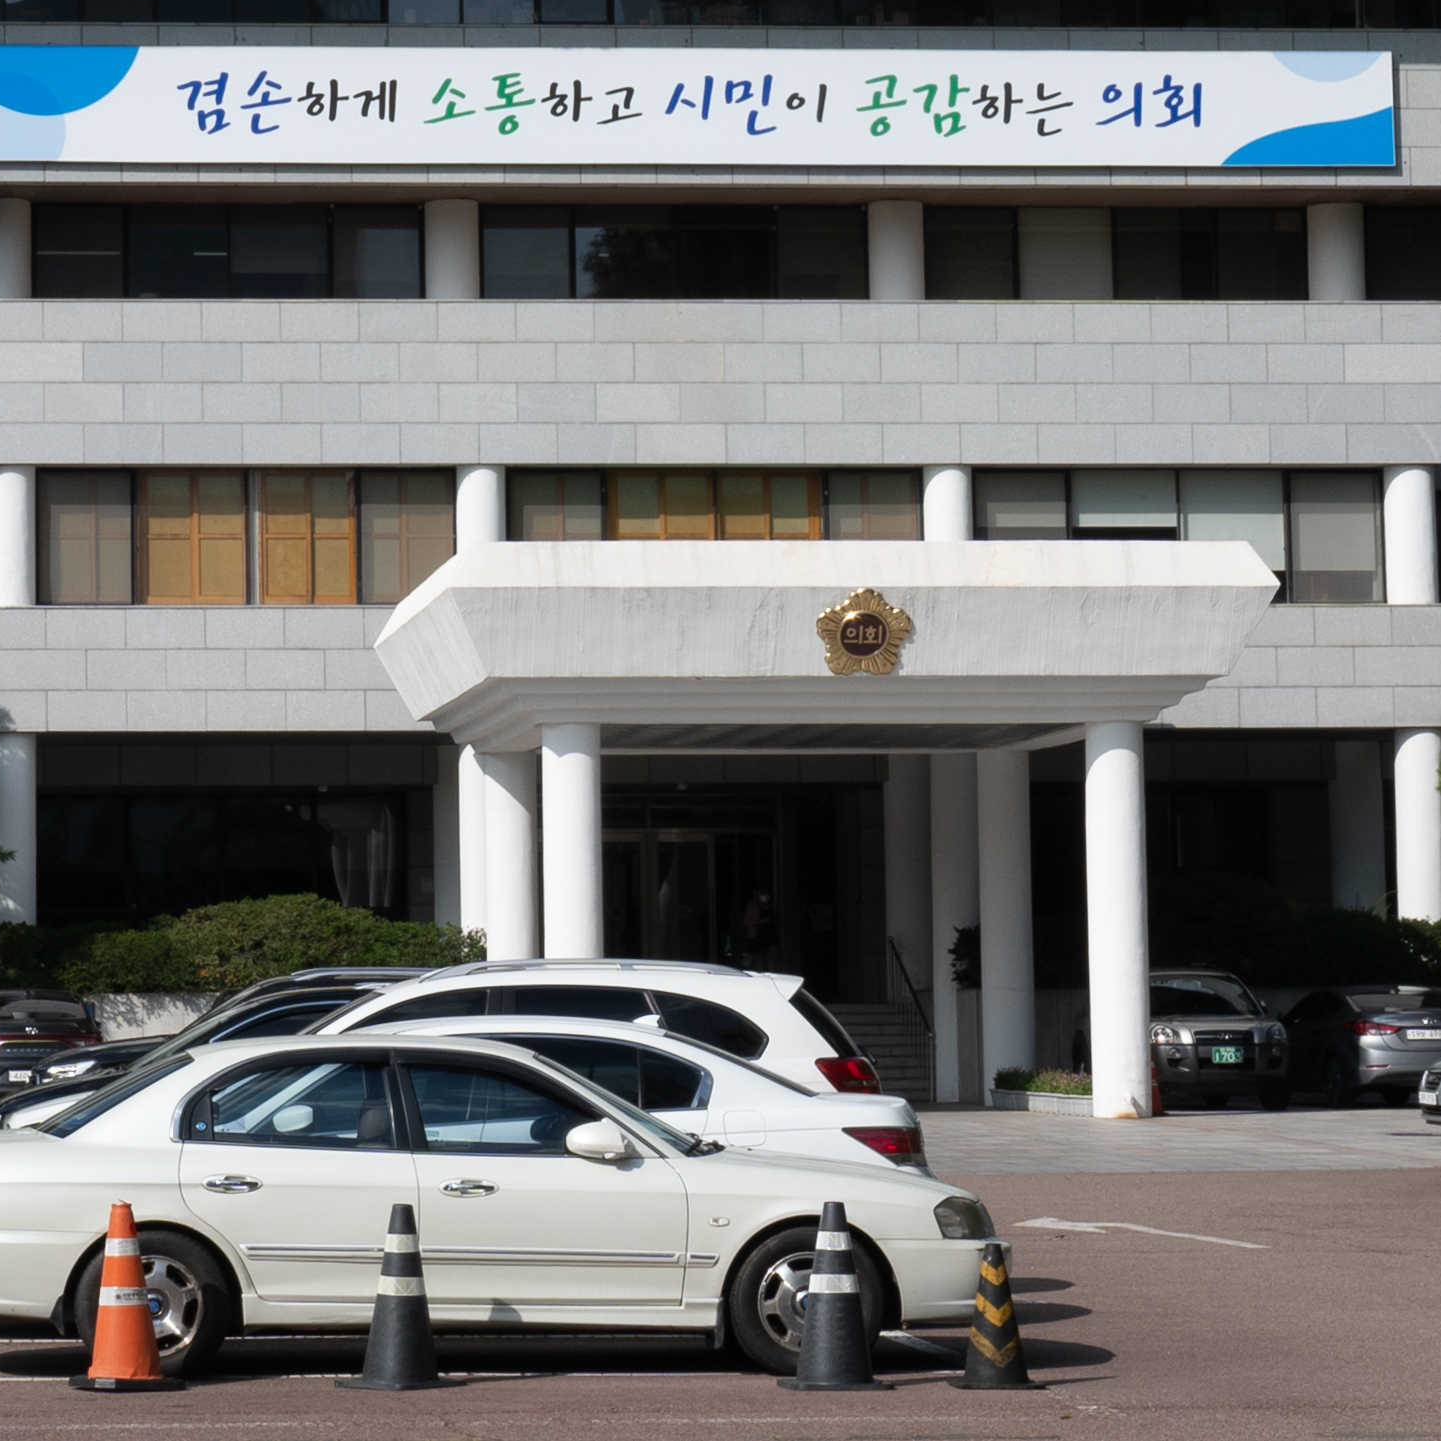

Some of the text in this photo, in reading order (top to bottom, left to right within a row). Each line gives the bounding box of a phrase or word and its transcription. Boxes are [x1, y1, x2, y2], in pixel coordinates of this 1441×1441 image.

[176, 70, 1202, 138] 겸손하게 소통하고 시민이 공감하는 의회
[843, 625, 882, 644] 의회
